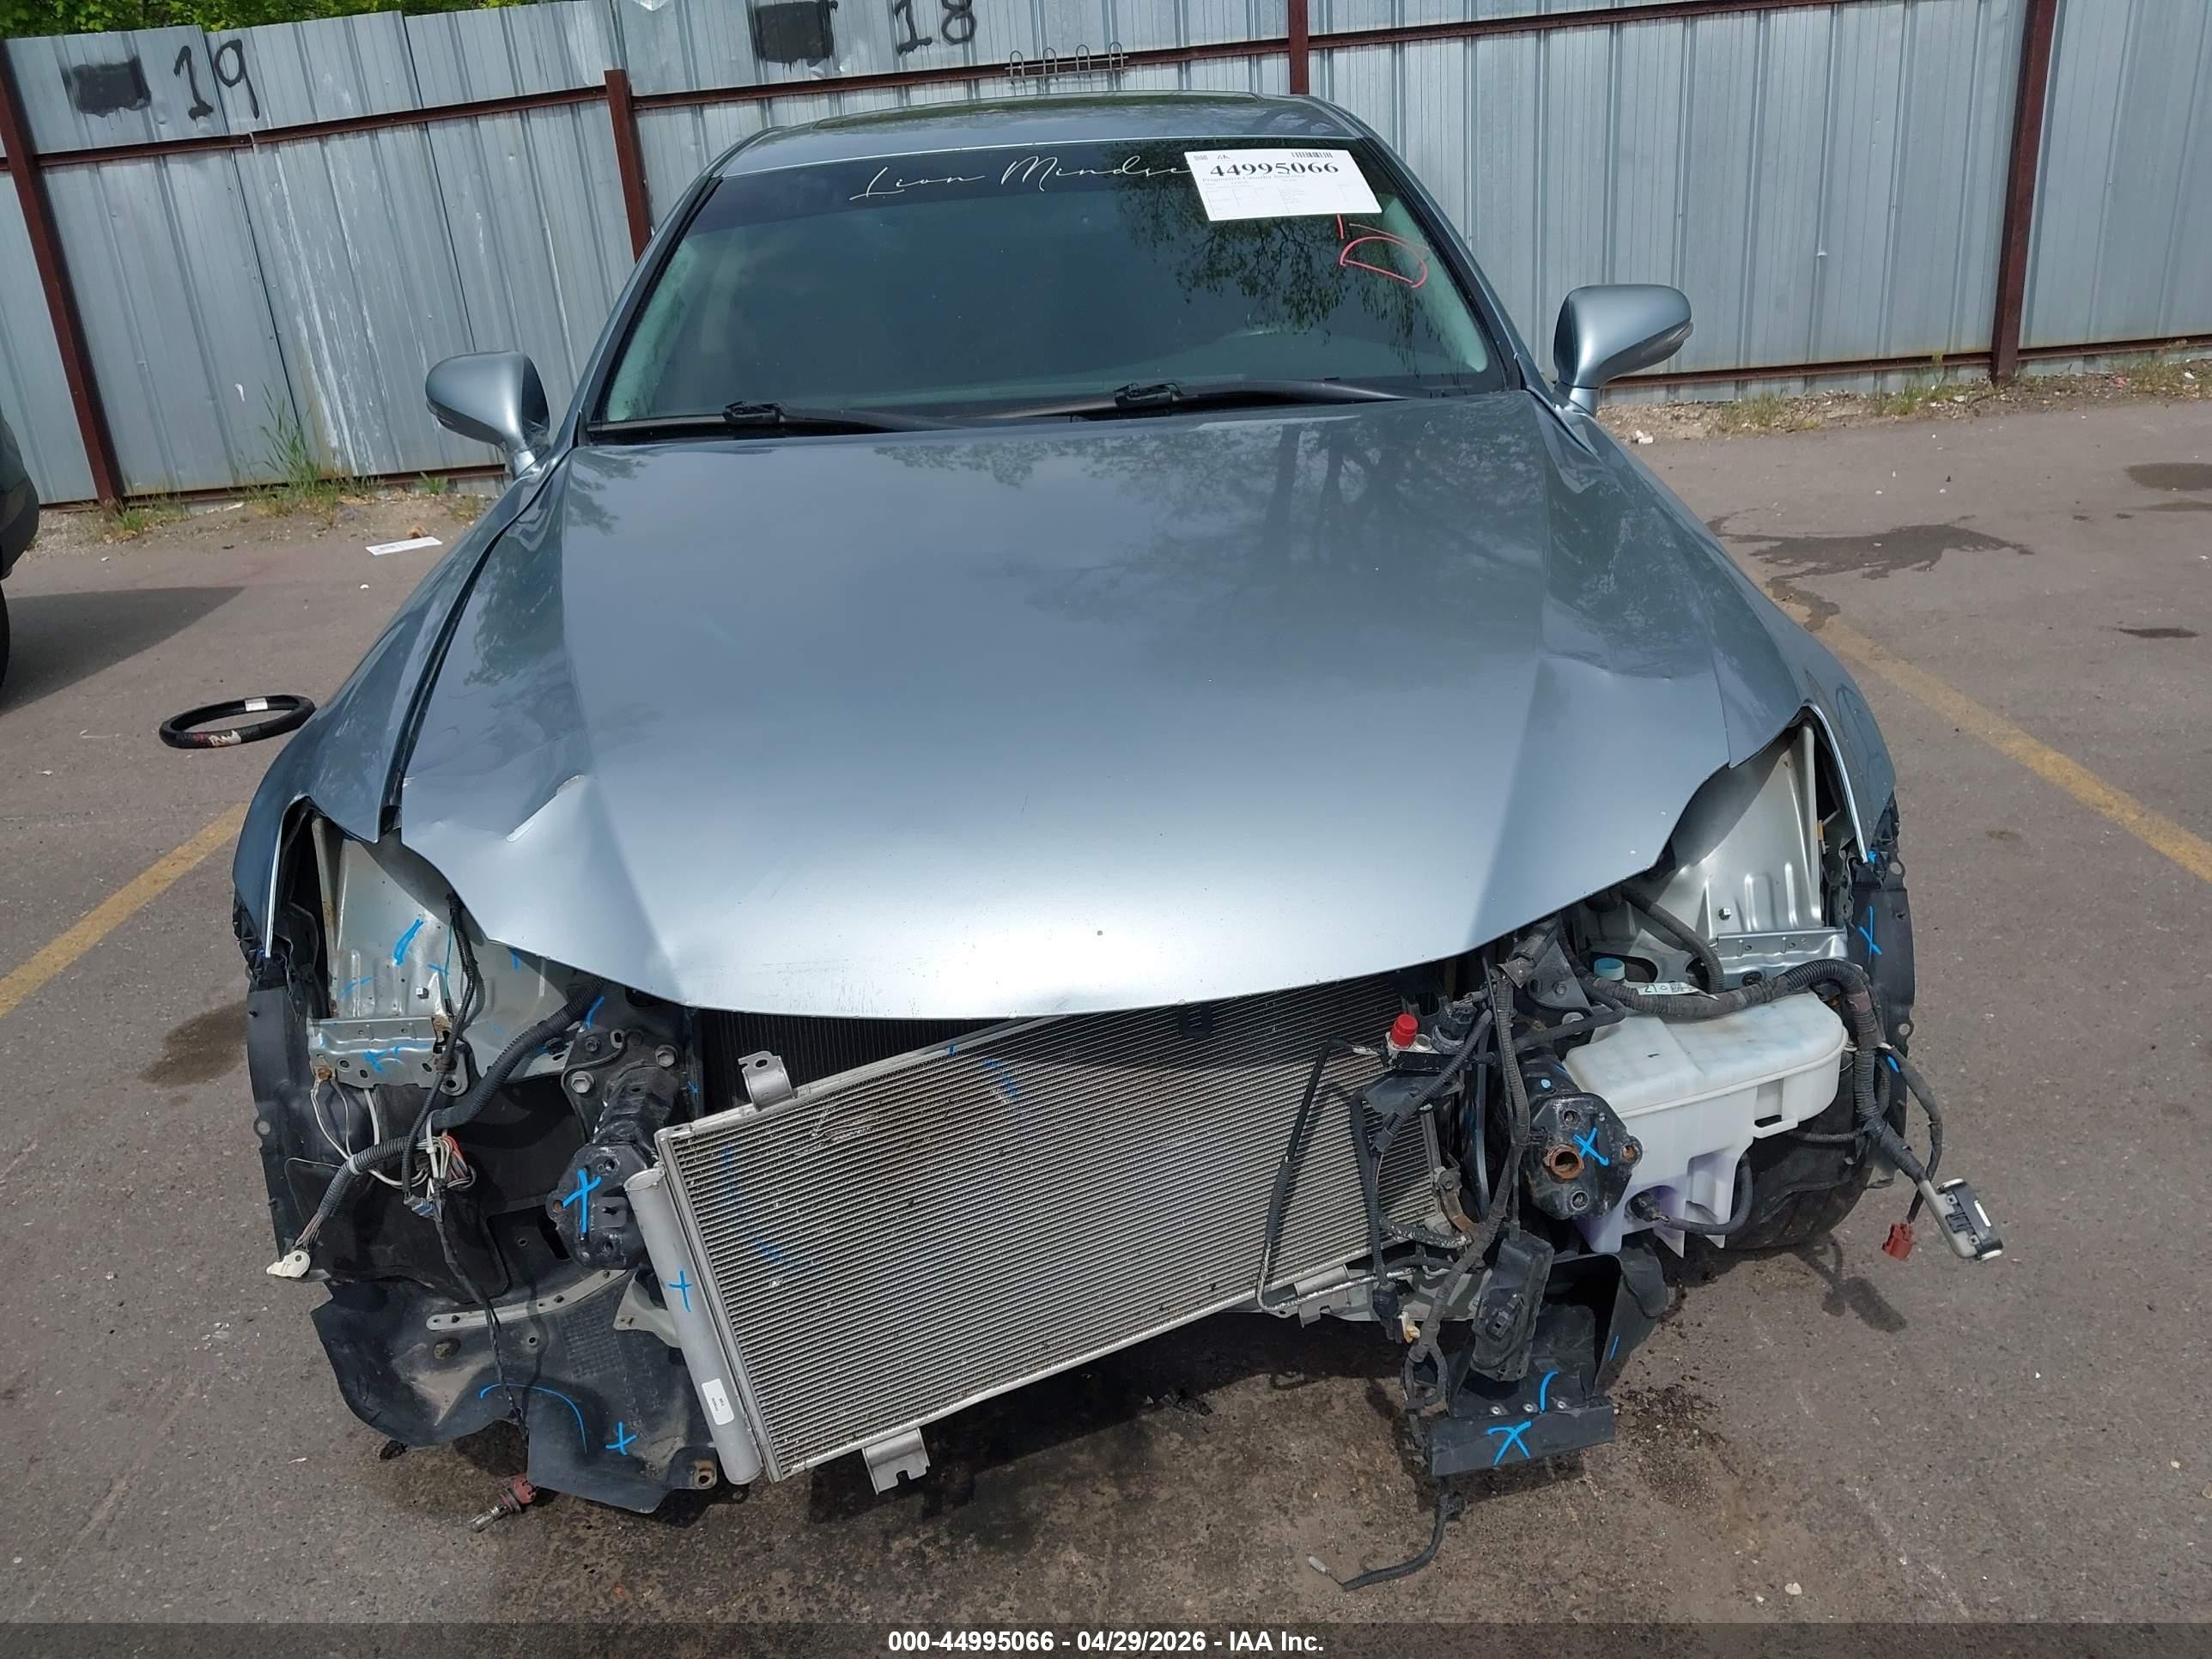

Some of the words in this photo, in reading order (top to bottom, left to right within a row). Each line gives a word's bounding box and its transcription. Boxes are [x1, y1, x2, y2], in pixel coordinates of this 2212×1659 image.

[894, 0, 977, 56] 18
[173, 39, 260, 120] 19
[849, 167, 986, 201] Lion
[1210, 161, 1339, 177] 44995066
